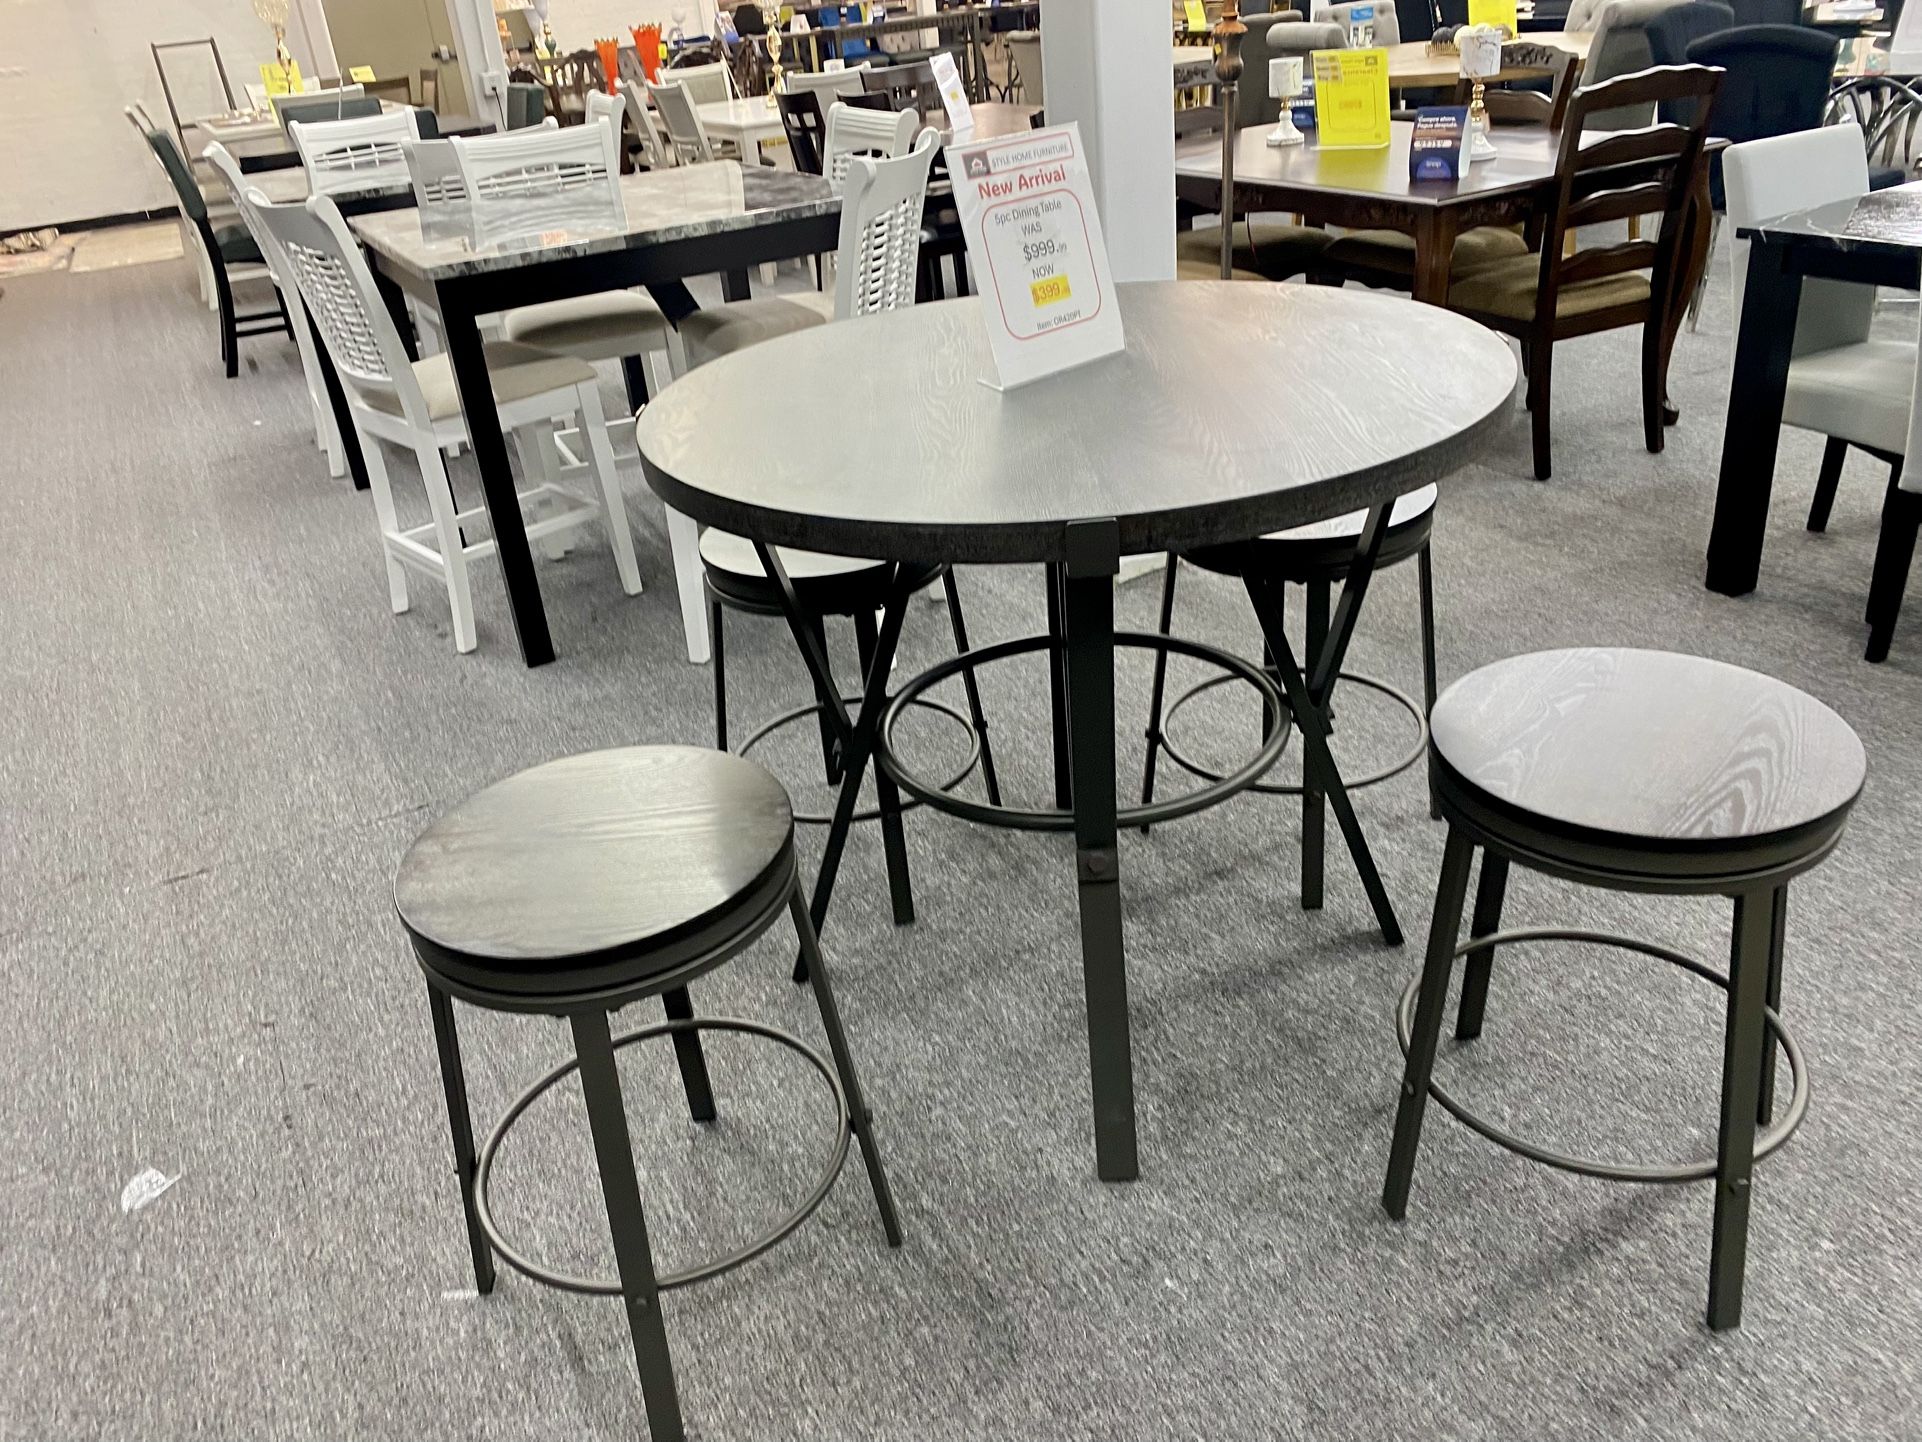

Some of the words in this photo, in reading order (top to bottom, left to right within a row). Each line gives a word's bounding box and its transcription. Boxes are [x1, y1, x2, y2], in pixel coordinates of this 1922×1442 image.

[991, 156, 1010, 169] STYLE
[1011, 151, 1032, 164] HOME
[1032, 143, 1068, 159] FURNITURE
[978, 181, 1013, 200] New
[1018, 163, 1067, 192] Arrival
[994, 211, 1011, 228] 5pc
[1012, 204, 1040, 222] Dining
[1041, 200, 1062, 214] Table
[1021, 222, 1043, 237] WAS
[1032, 264, 1055, 280] NOW
